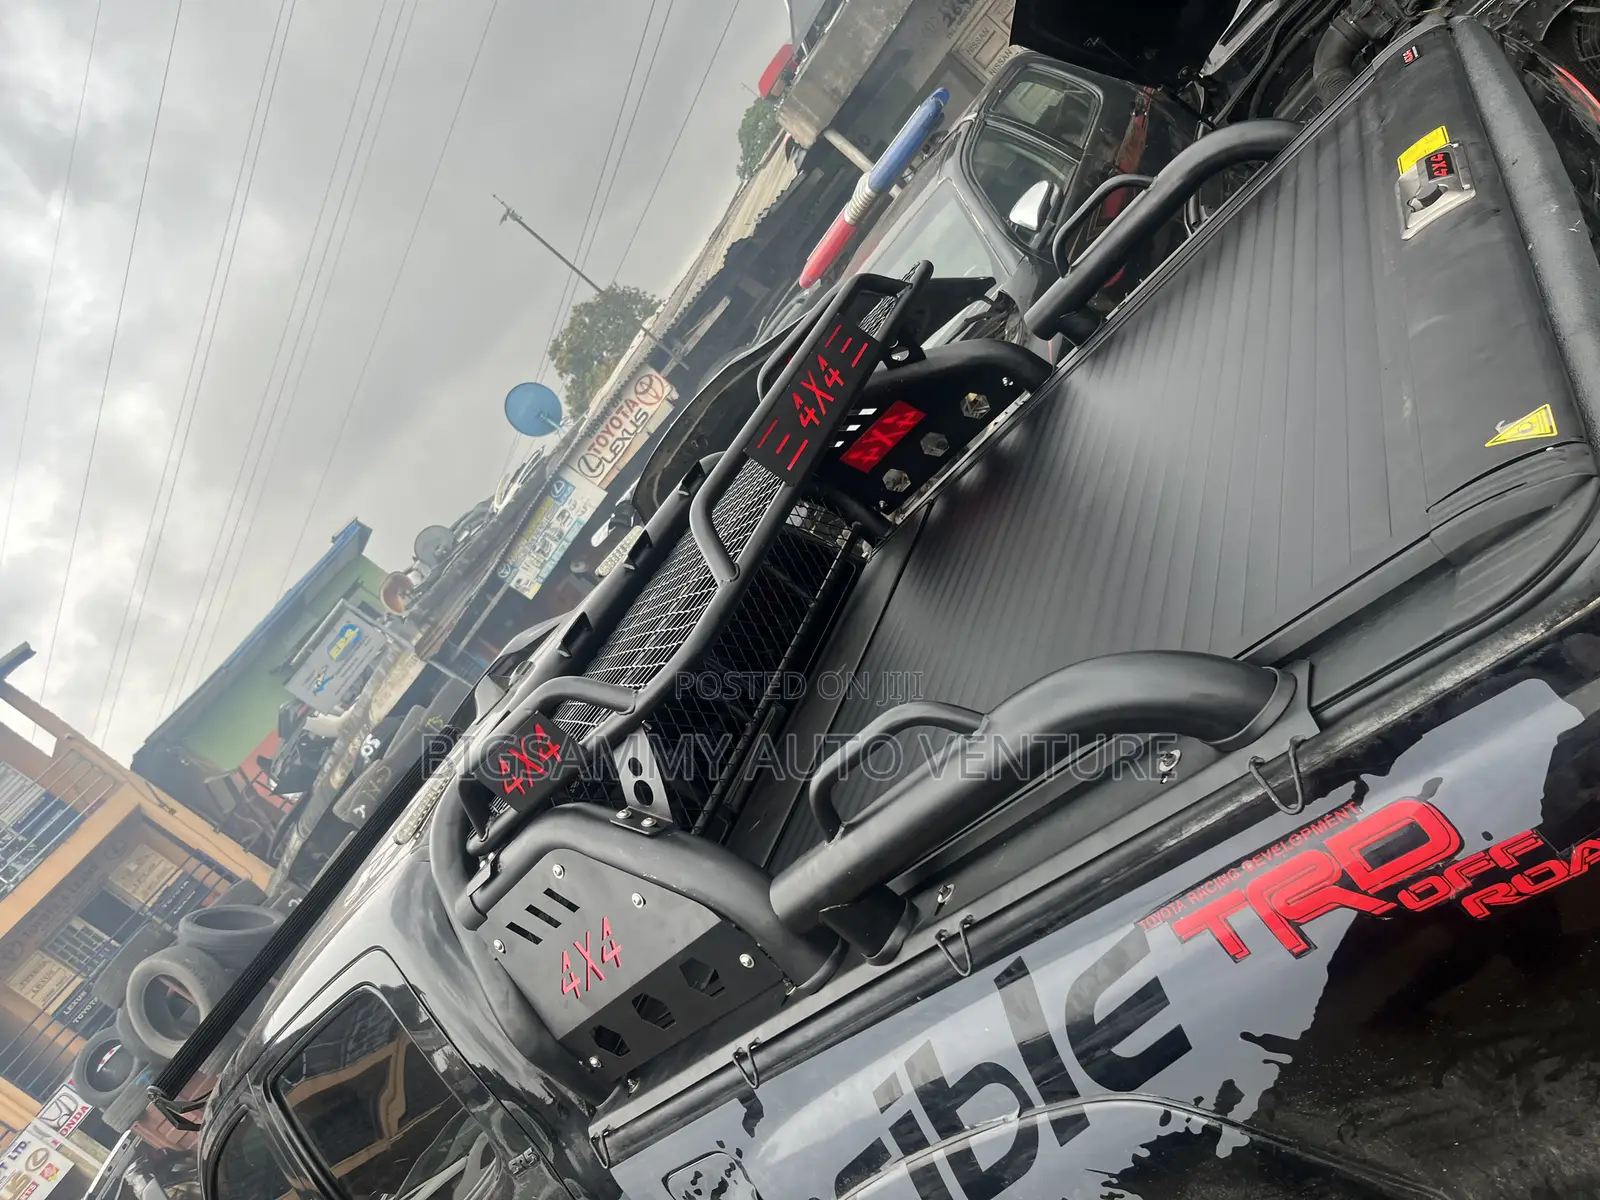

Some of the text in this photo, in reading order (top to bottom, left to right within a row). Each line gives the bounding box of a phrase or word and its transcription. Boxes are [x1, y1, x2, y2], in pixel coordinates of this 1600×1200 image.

[966, 27, 989, 55] NISSAN
[989, 48, 1013, 76] NISSAN
[792, 354, 844, 428] 4X4
[588, 398, 639, 455] TOYOTA
[601, 408, 649, 463] LEXUS
[498, 722, 563, 796] 4X4
[1138, 800, 1361, 933] TOYOTA RACING DEVELOPMENT
[1171, 799, 1463, 963] TRD
[1397, 829, 1544, 912] OFF
[561, 916, 622, 1000] 4X4
[63, 991, 87, 1015] LEXUS
[8, 1140, 31, 1161] LTD.
